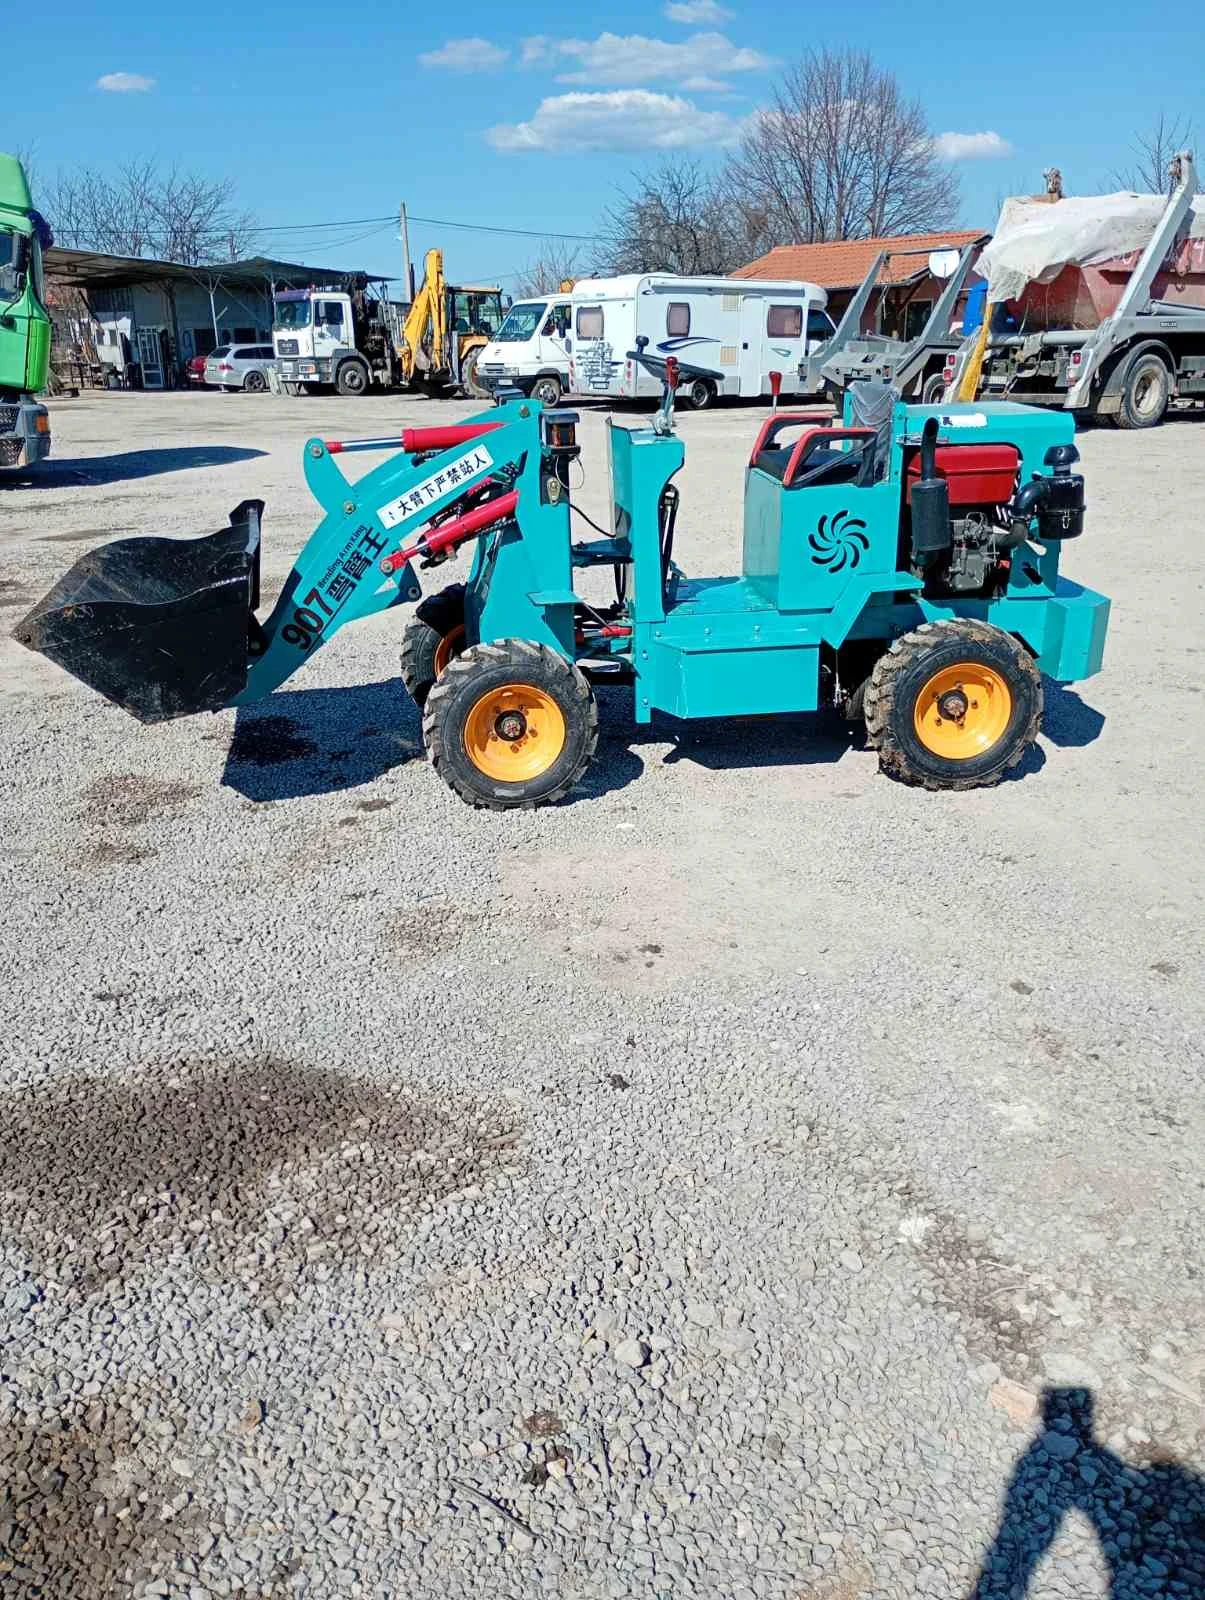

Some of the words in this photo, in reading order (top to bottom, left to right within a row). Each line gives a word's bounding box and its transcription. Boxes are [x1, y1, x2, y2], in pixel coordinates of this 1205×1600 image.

[281, 587, 333, 650] 907
[325, 526, 389, 602] 弯臂王
[317, 557, 343, 588] Bending
[339, 541, 353, 558] Arm
[350, 524, 366, 542] King
